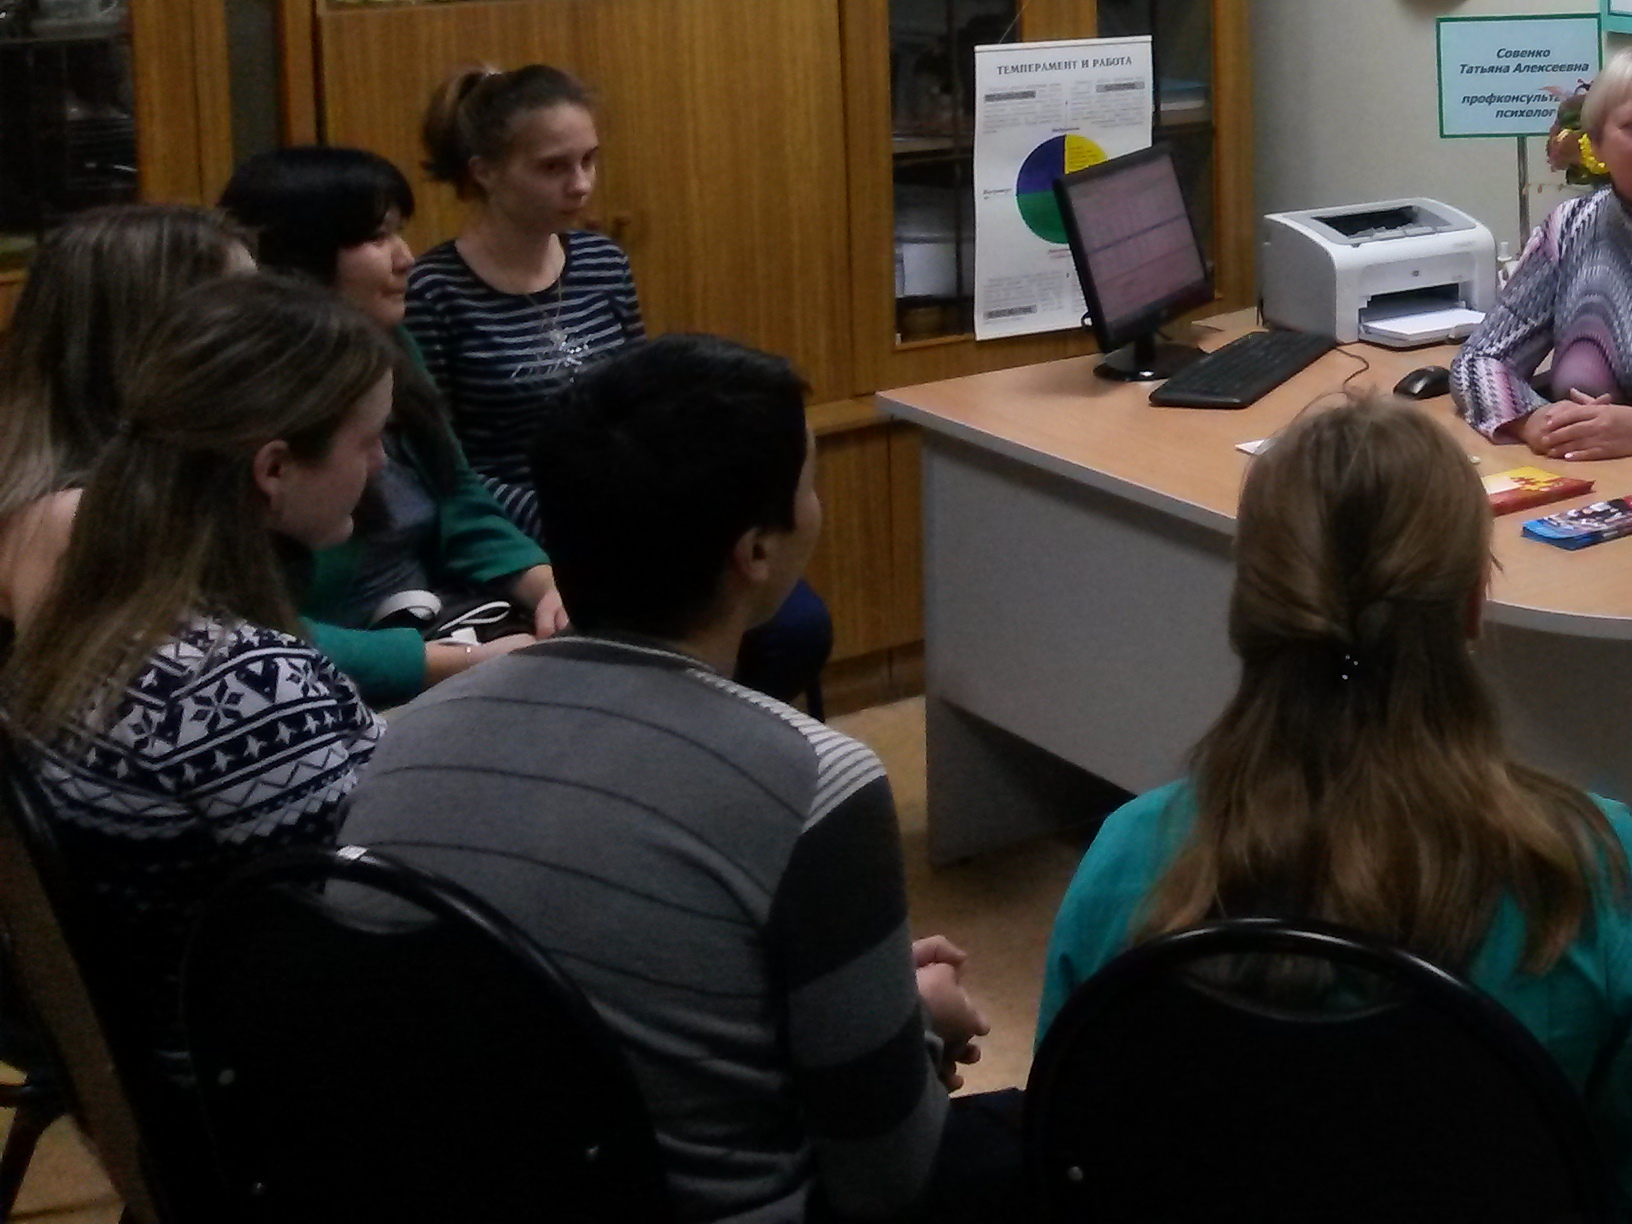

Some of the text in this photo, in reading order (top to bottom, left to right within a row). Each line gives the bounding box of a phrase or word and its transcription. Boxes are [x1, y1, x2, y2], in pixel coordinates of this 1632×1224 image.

[1496, 48, 1551, 59] Совенко
[997, 56, 1132, 75] ТЕМПЕРАМЕНТ И РАБОТА
[1459, 61, 1589, 74] Татьяна Алексеевна
[1495, 109, 1557, 119] психолог
